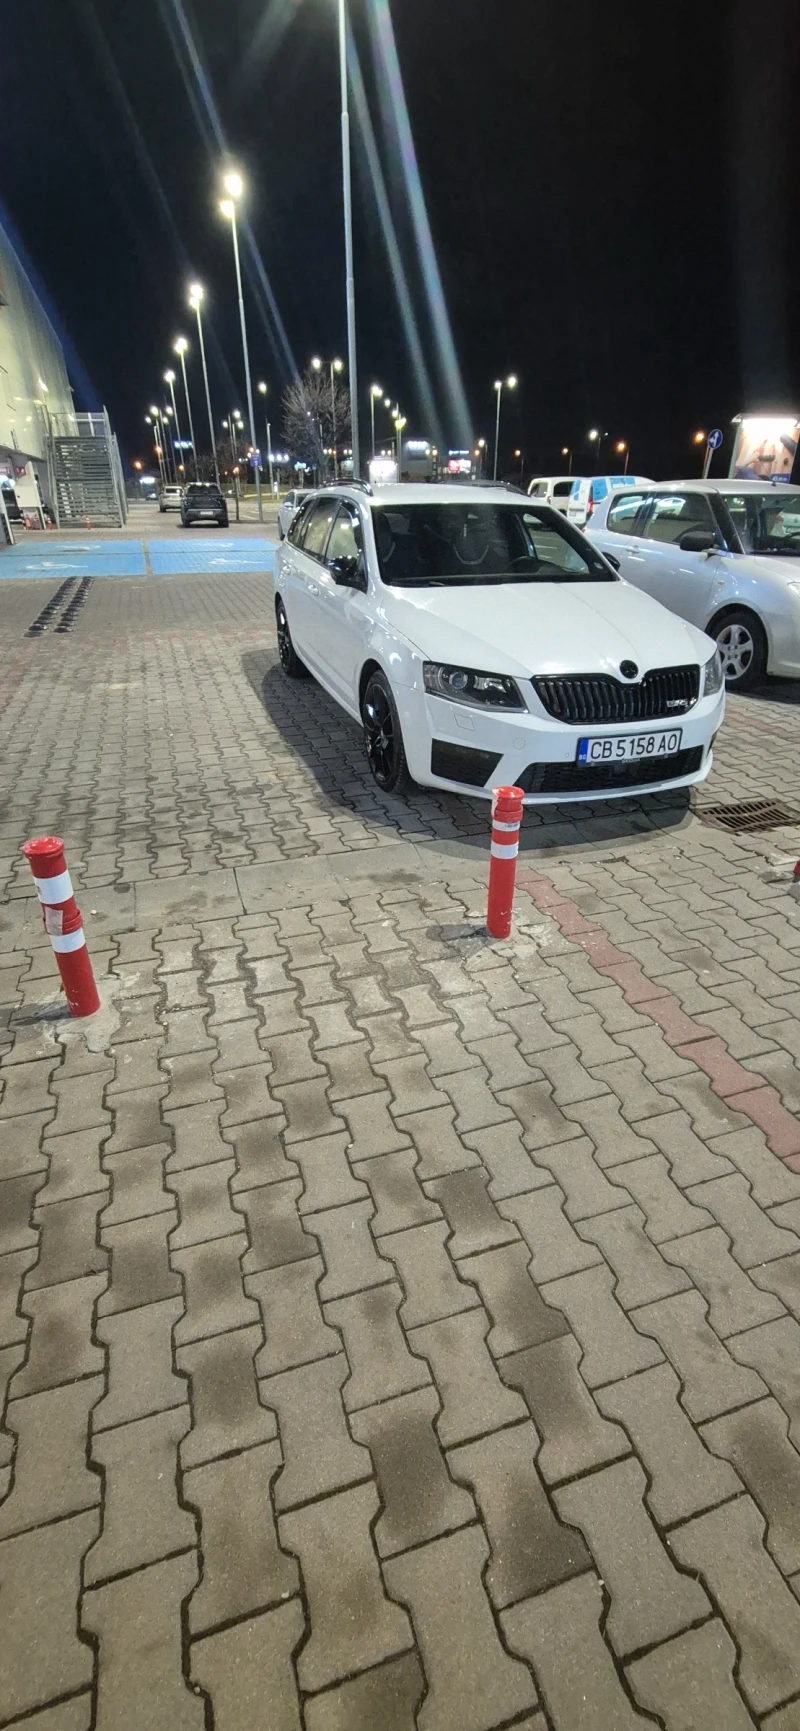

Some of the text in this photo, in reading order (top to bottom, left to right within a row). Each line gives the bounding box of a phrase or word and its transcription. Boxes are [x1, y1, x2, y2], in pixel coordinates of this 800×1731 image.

[591, 734, 677, 759] CB 5158 AO
